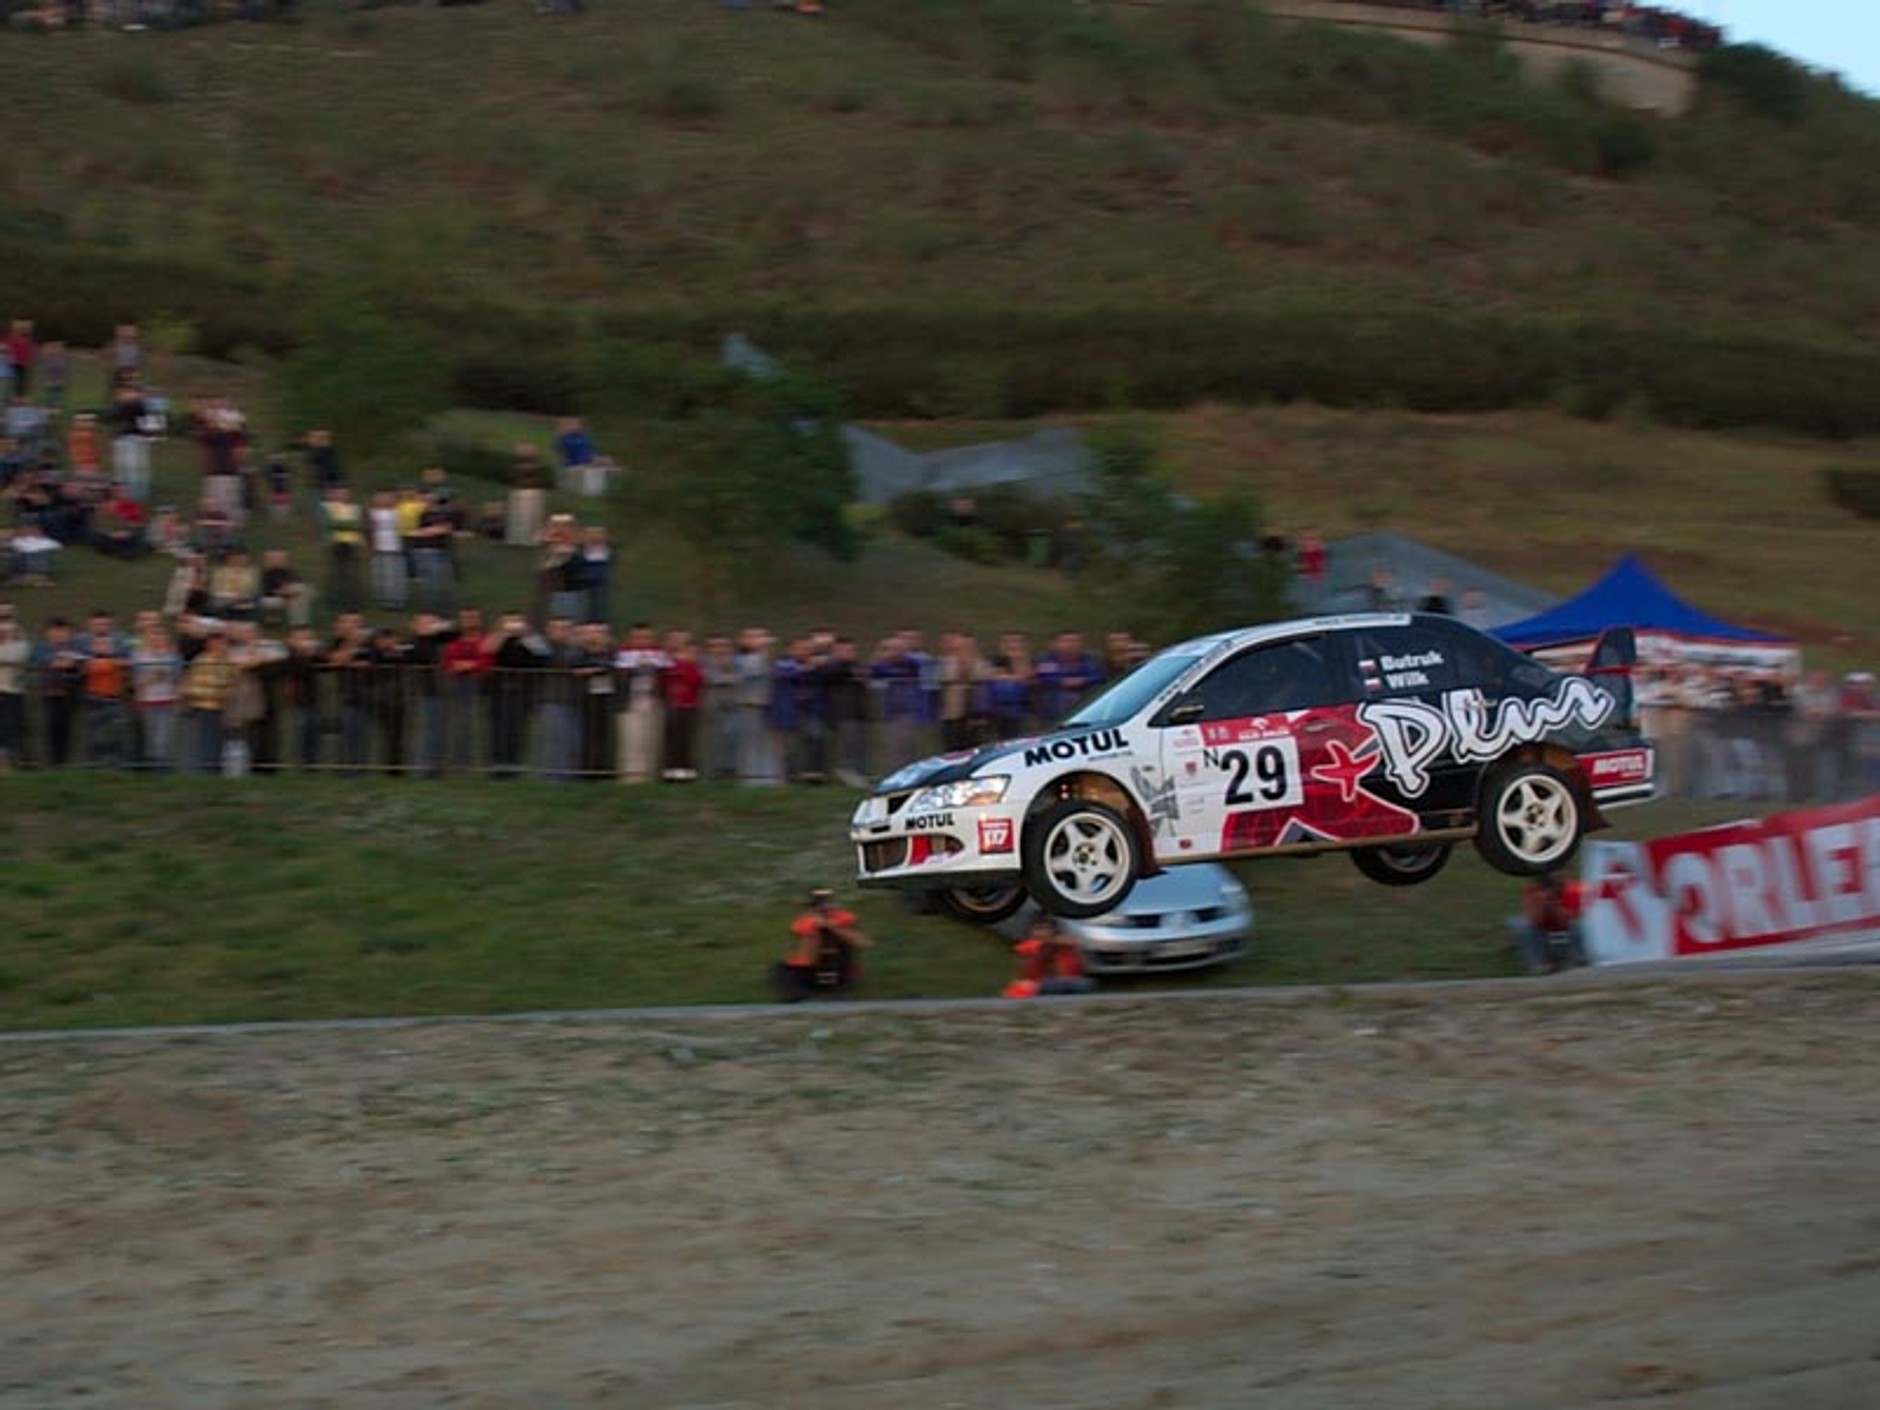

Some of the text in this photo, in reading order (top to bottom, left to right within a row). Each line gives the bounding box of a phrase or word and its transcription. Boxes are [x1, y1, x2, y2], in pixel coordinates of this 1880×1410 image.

[1025, 728, 1129, 767] MOTUL
[1358, 677, 1612, 797] Plus
[1203, 746, 1287, 805] N 29
[905, 813, 955, 830] MOTUL
